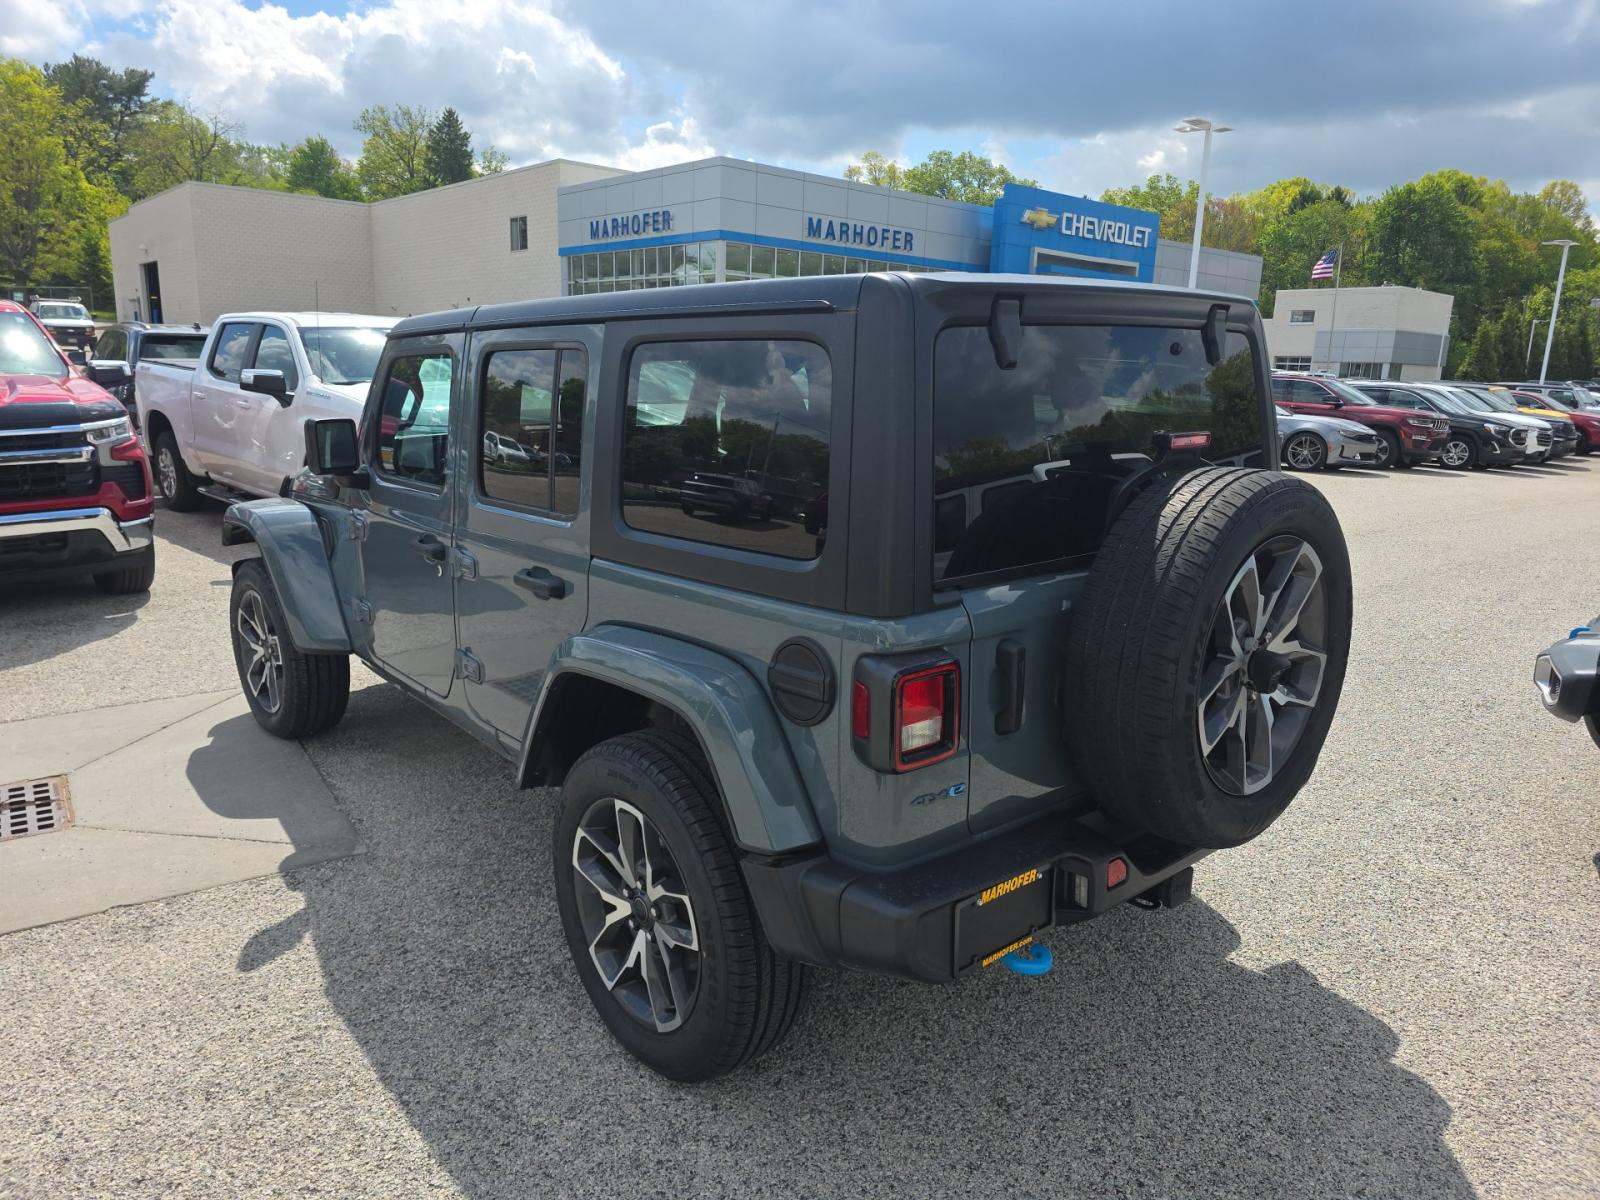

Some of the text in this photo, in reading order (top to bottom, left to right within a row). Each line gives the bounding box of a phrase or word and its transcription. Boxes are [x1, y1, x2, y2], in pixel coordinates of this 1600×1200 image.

[590, 210, 672, 240] MARHOFER
[807, 216, 914, 252] MARHOFER
[1061, 212, 1152, 248] CHEVROLET
[981, 868, 1037, 904] MARHOFER
